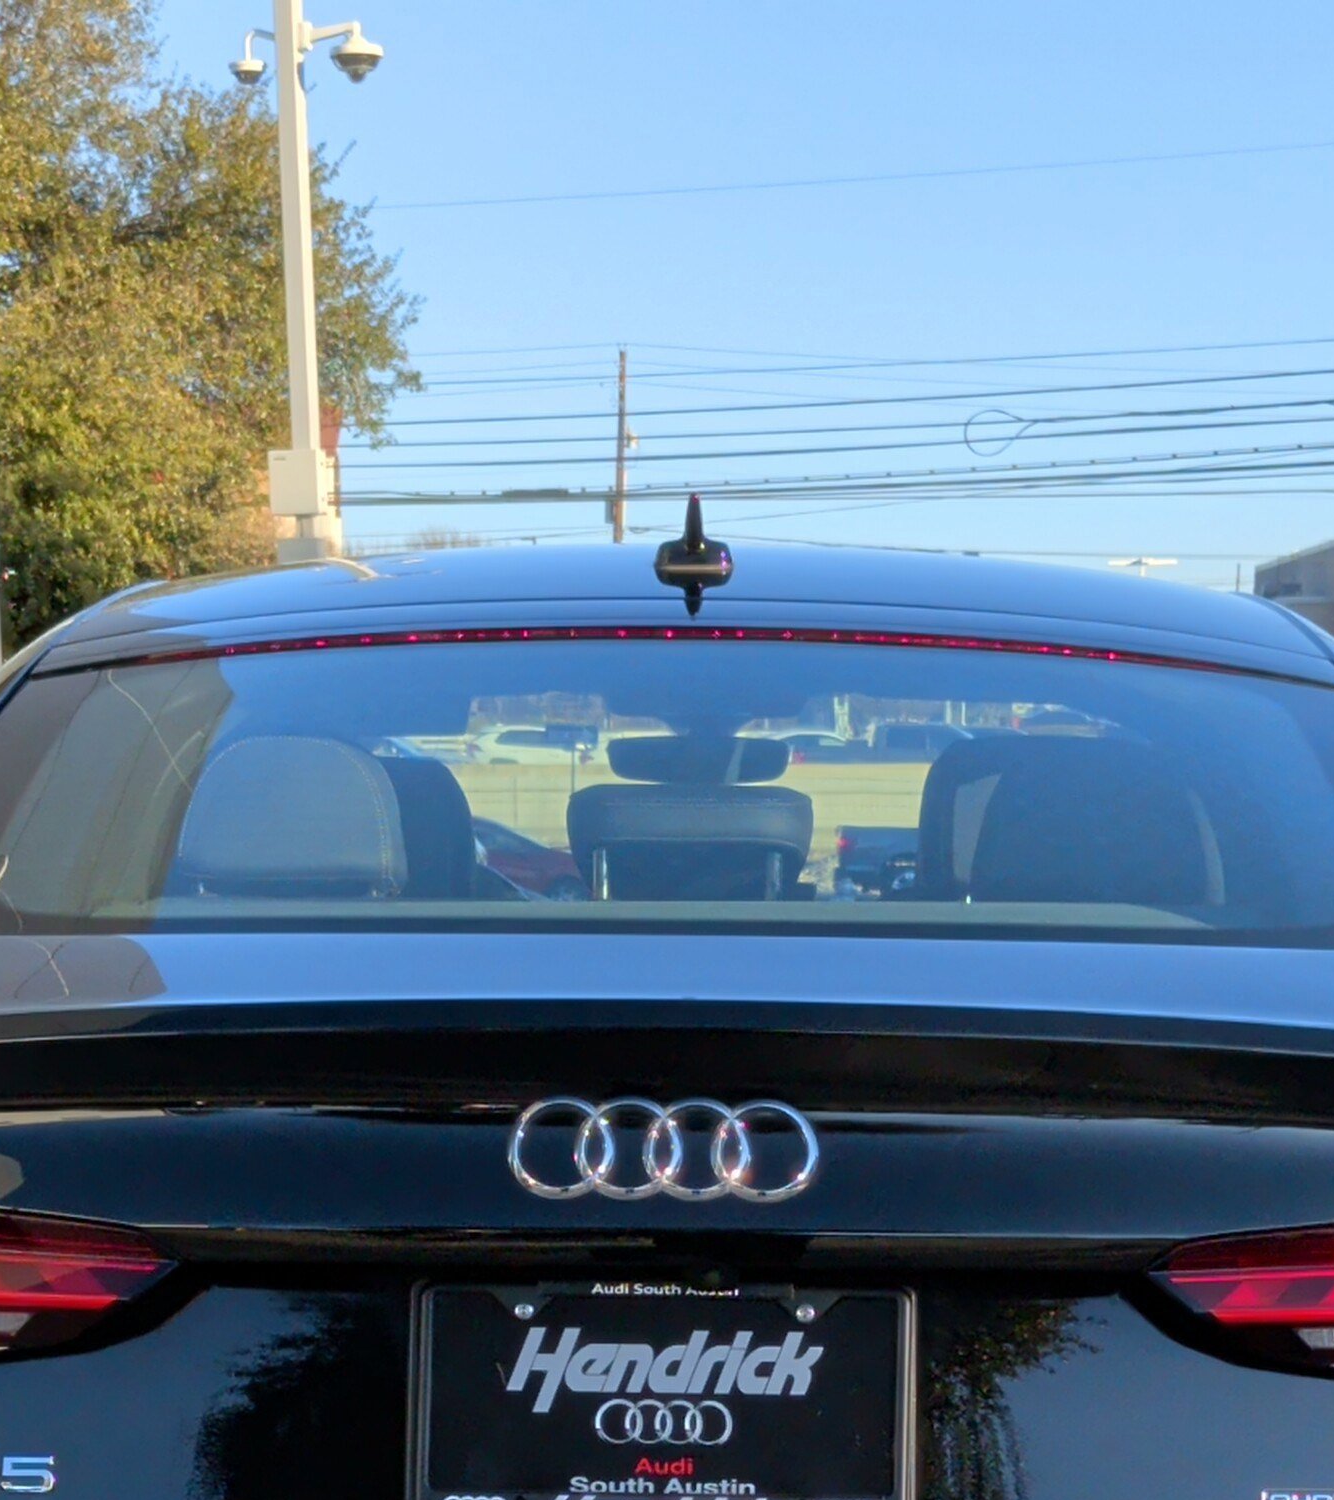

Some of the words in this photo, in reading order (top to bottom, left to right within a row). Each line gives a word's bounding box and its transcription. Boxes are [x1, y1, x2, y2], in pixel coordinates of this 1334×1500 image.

[591, 1282, 629, 1295] Audi
[633, 1282, 682, 1295] South
[506, 1327, 824, 1413] Hendrick
[634, 1458, 694, 1475] Audi
[569, 1476, 655, 1494] South
[664, 1477, 756, 1495] Austin
